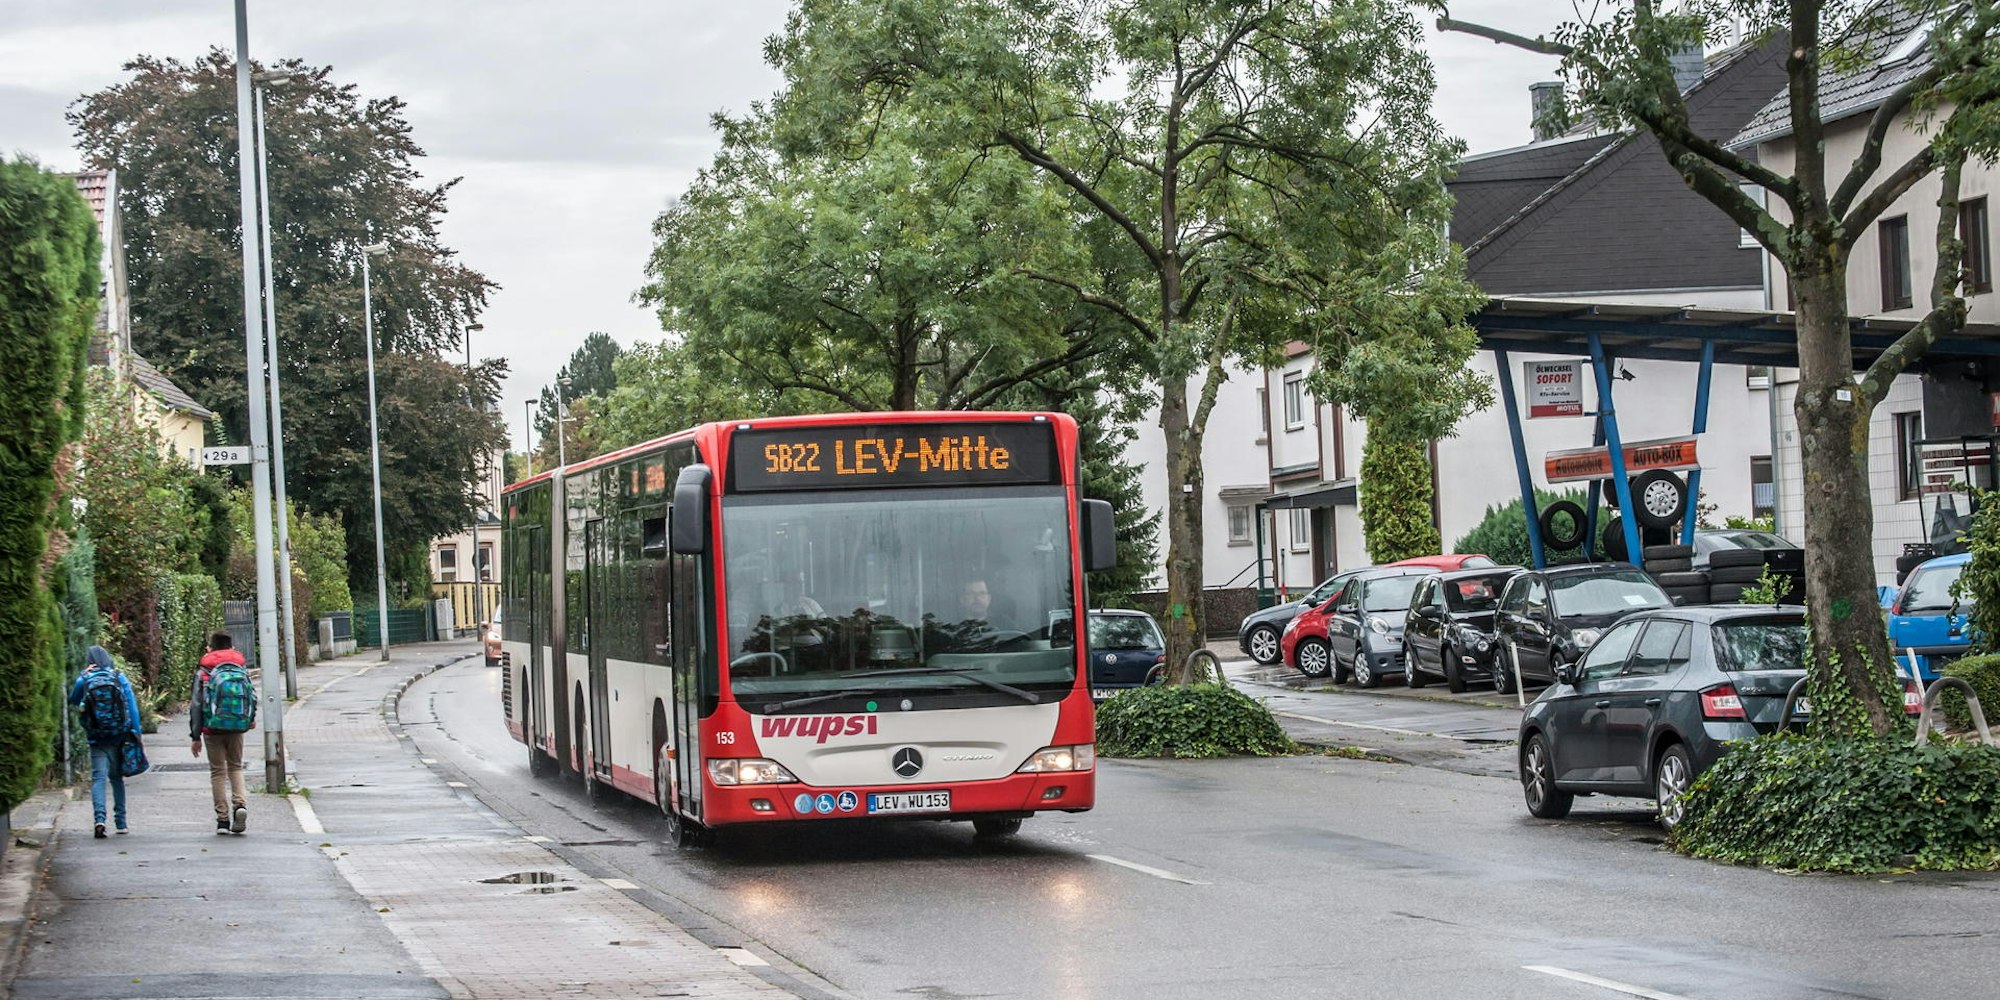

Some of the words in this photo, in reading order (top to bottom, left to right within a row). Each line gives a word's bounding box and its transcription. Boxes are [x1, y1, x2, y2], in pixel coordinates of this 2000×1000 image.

[1536, 373, 1573, 384] SOFORT
[213, 451, 228, 460] 29
[764, 443, 821, 473] SB22
[835, 435, 1010, 474] LEV-Mitte
[1633, 446, 1682, 466] AUTO-BOX
[1797, 699, 1806, 711] K
[761, 704, 878, 743] wupsi
[715, 731, 735, 745] 153
[876, 796, 900, 810] LEV
[908, 795, 925, 809] WU
[926, 793, 948, 808] 153
